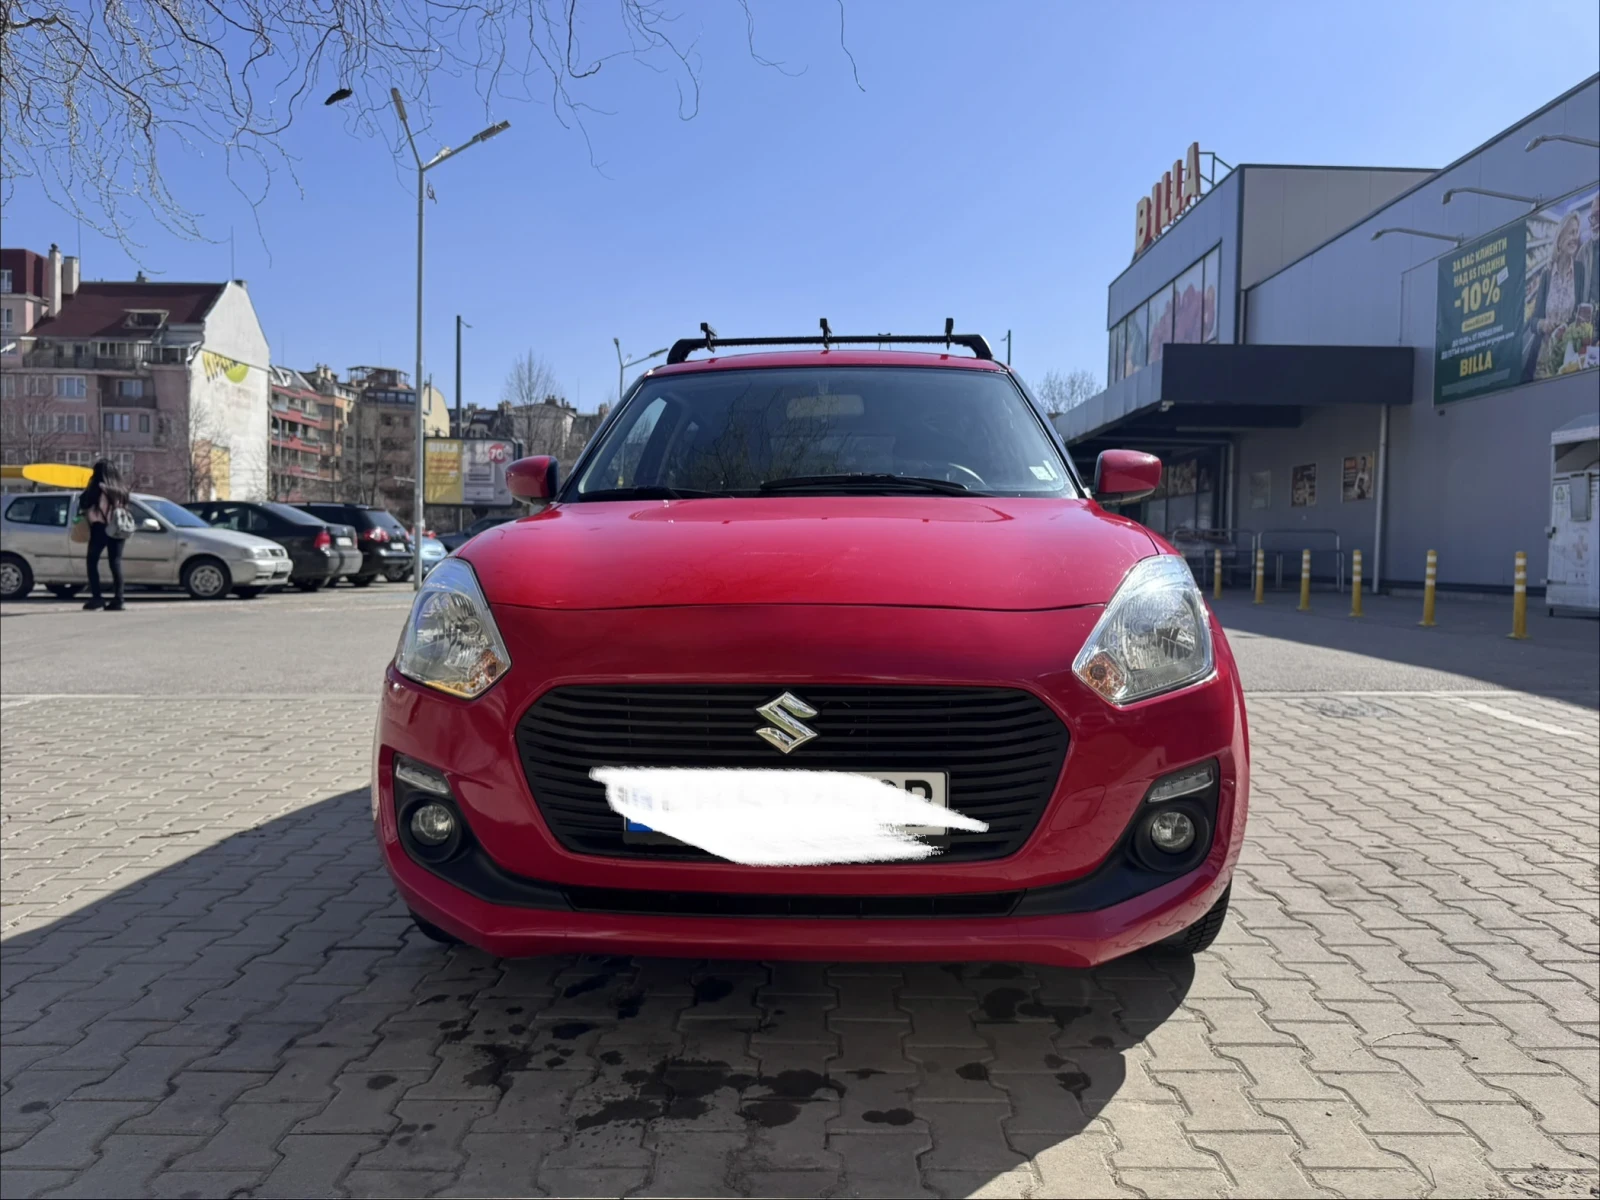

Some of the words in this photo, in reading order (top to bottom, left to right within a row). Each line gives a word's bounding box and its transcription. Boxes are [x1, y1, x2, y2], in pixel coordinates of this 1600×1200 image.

[1135, 142, 1201, 254] BILLA
[1452, 259, 1461, 272] ЗА
[1475, 237, 1508, 262] КЛИЕНТИ
[1453, 271, 1469, 288] НАД
[1477, 254, 1506, 276] ГОДИНИ
[1454, 275, 1500, 314] -10%
[1459, 350, 1493, 377] BILLA
